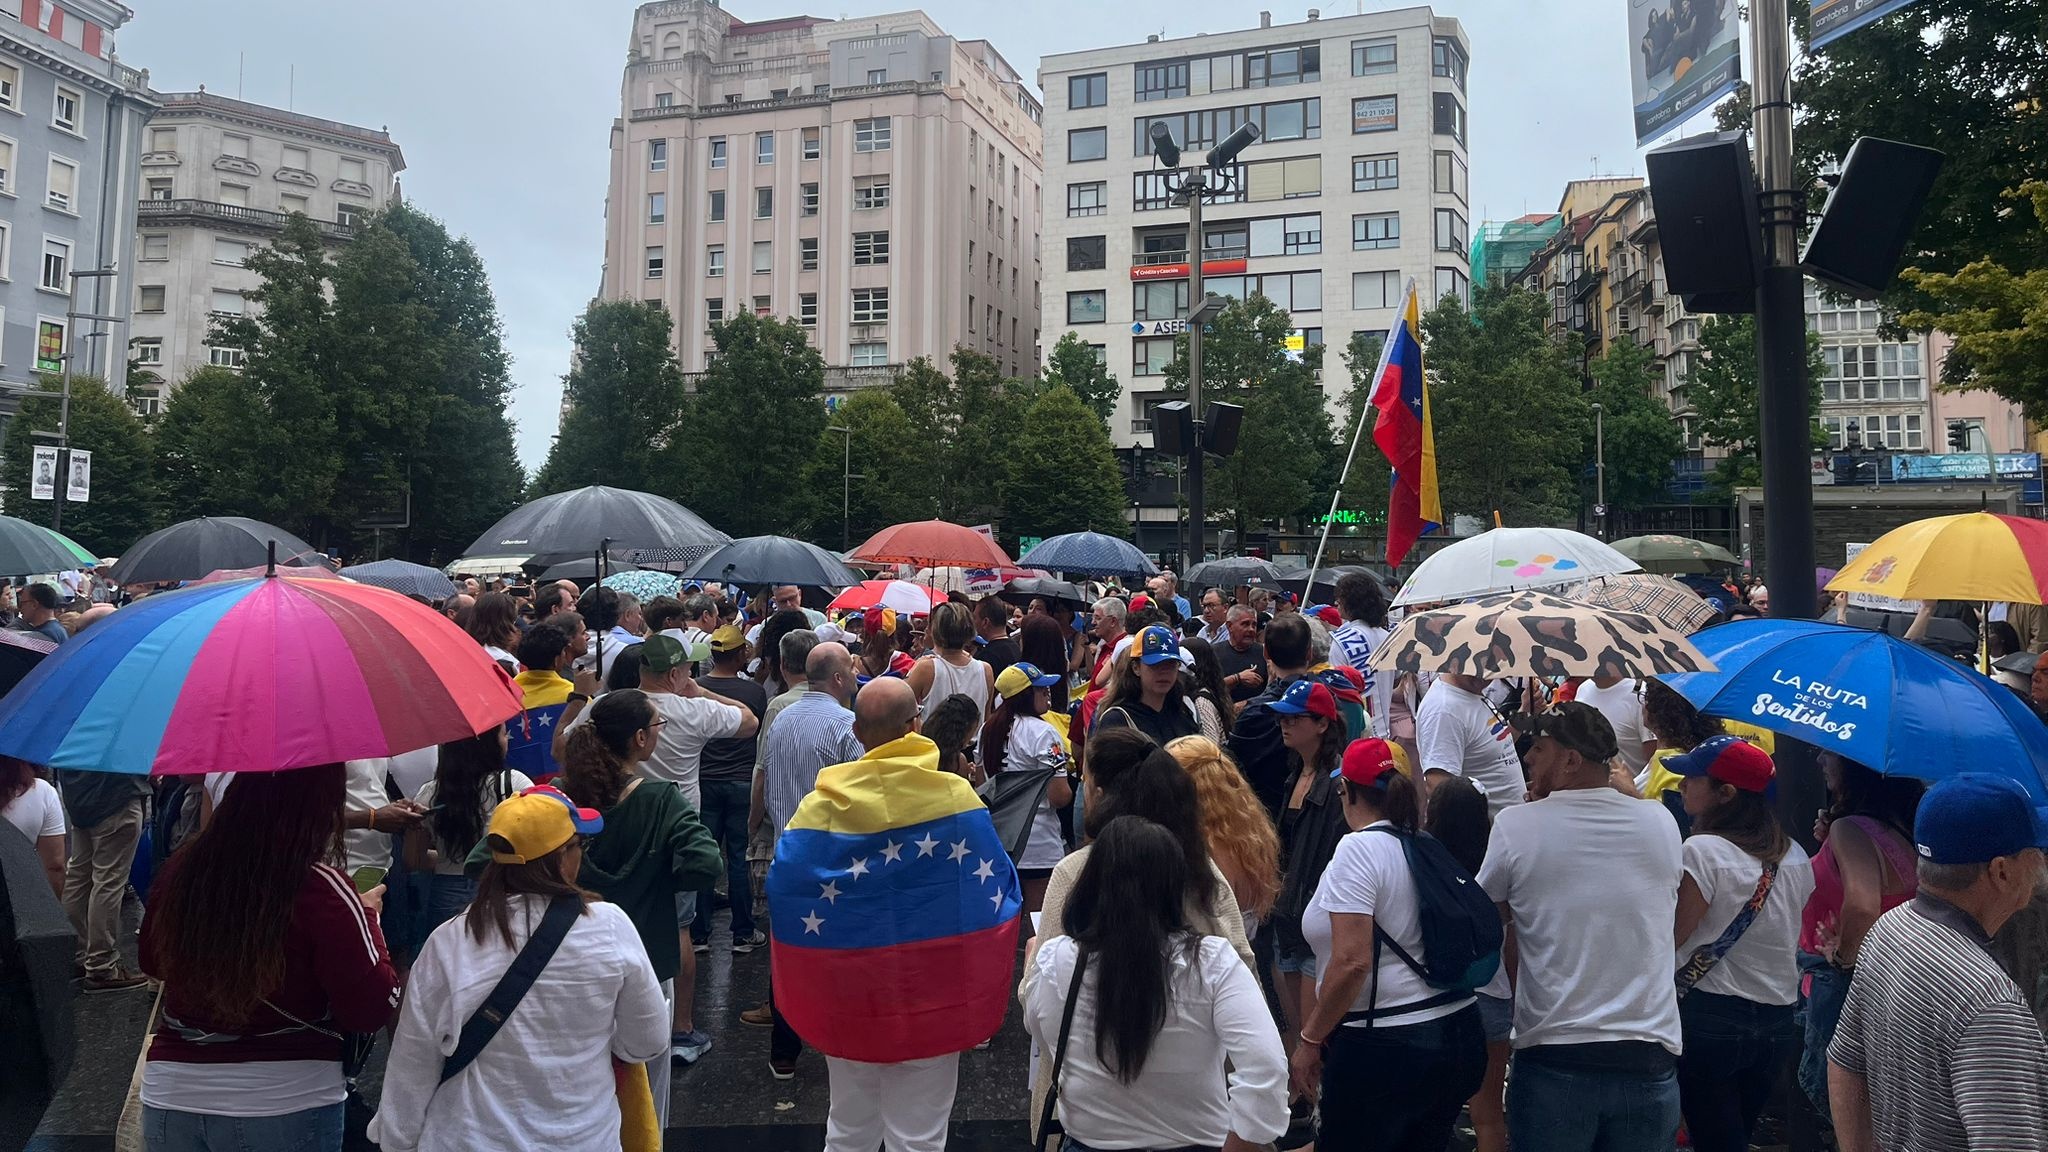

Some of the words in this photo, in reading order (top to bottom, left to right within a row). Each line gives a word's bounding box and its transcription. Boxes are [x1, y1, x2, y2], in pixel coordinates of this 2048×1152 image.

[1771, 669, 1801, 690] LA
[1807, 681, 1867, 710] RUTA
[1794, 692, 1810, 702] DE
[1811, 698, 1834, 710] LOS
[1751, 693, 1857, 741] Sentidos
